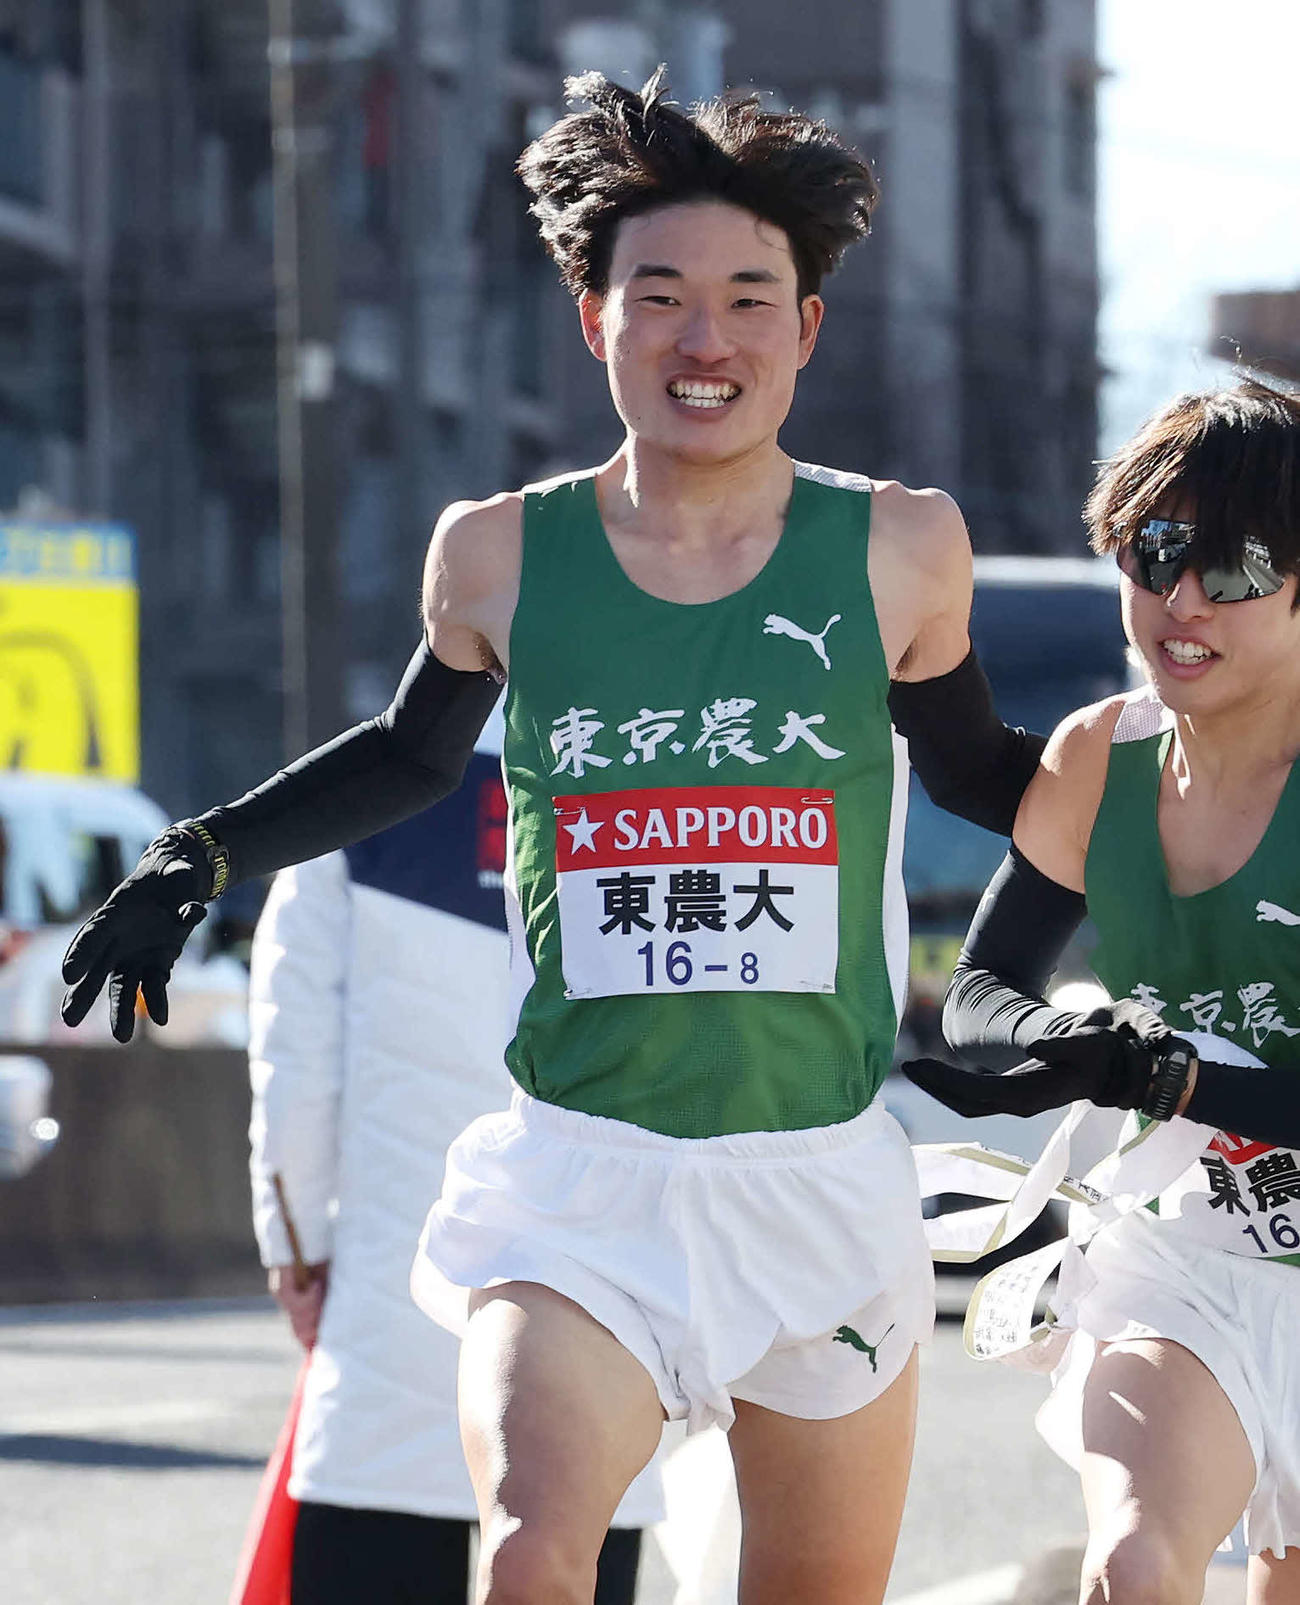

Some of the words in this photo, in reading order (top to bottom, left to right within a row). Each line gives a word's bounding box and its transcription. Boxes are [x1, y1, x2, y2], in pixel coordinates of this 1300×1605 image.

[549, 697, 846, 779] 東京農大
[614, 805, 828, 850] SAPPORO
[596, 869, 795, 936] 東農大
[1200, 1152, 1300, 1217] 東農
[1242, 1213, 1300, 1253] 16
